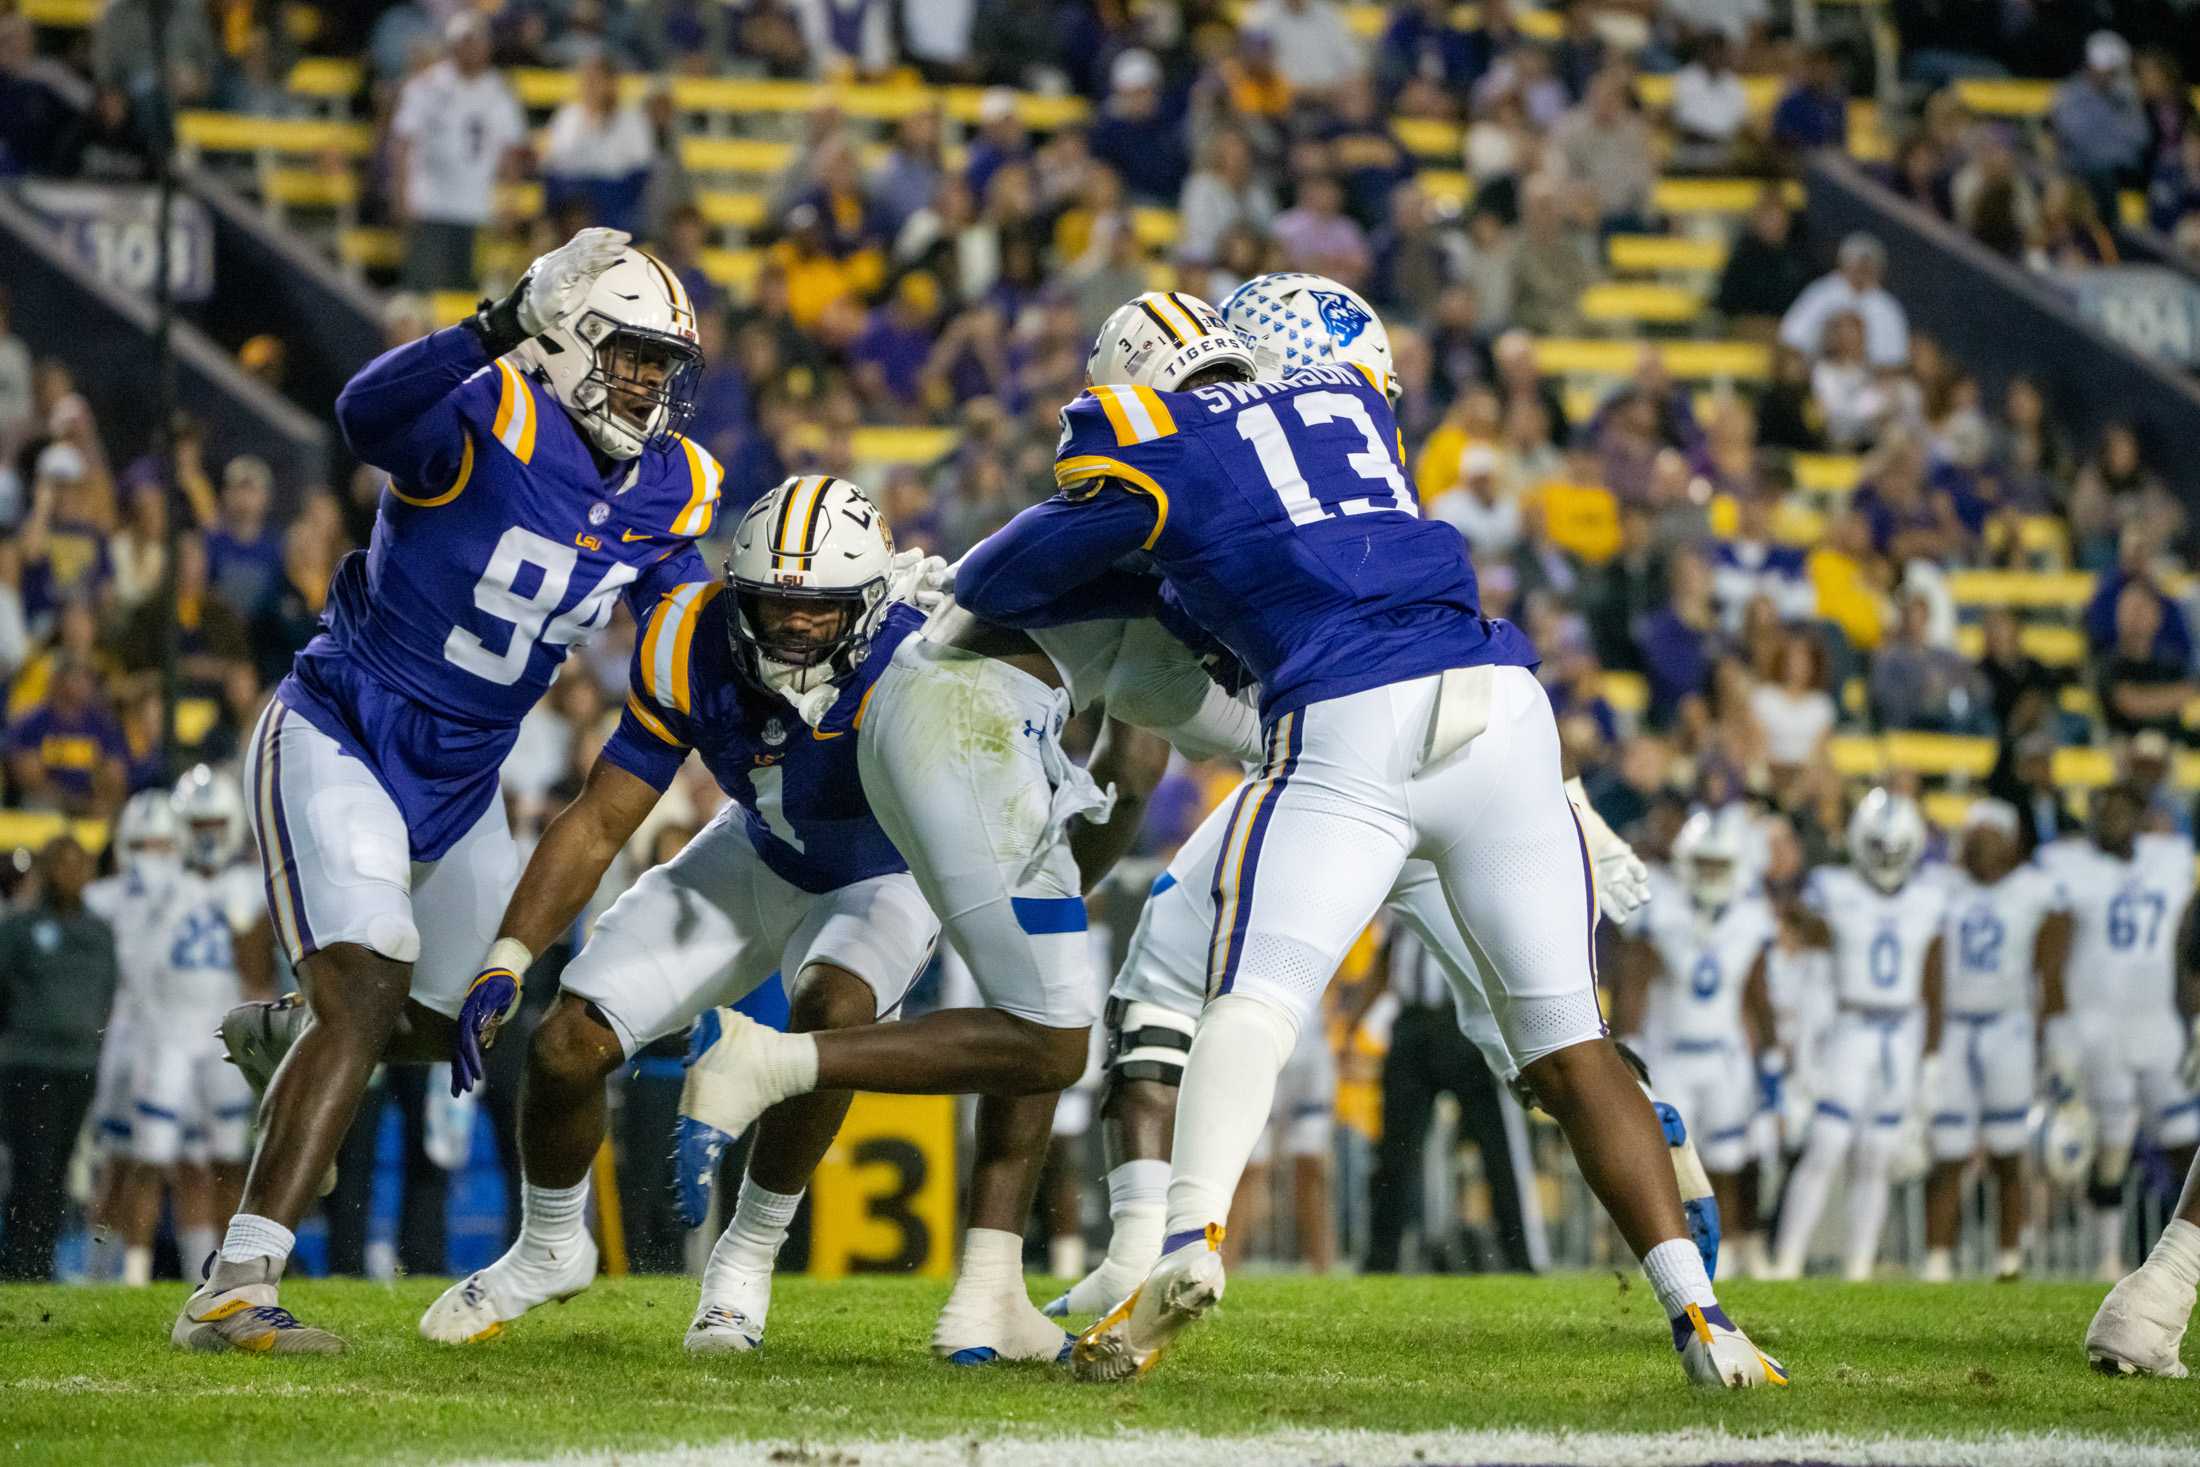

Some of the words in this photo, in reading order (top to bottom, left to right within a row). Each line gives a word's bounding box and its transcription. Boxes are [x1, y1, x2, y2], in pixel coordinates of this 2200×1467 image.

[1164, 338, 1240, 377] TIGERS
[1236, 390, 1419, 527] 13
[575, 531, 602, 552] LSU
[443, 525, 639, 686] 94
[774, 573, 804, 587] LSU
[747, 765, 806, 855] 1
[2108, 892, 2166, 950] 67
[1870, 929, 1900, 988] 0
[846, 1135, 930, 1274] 3
